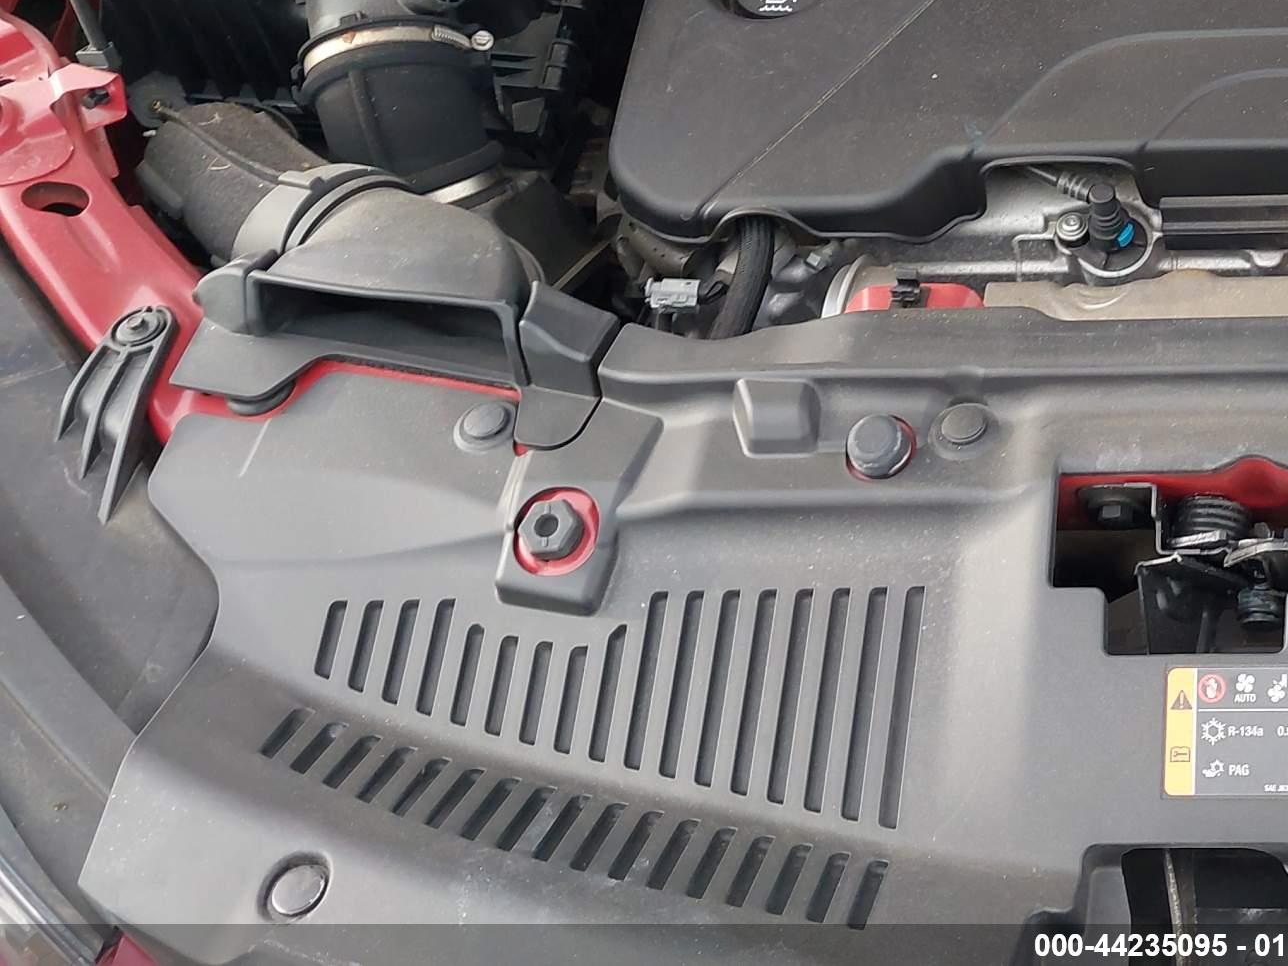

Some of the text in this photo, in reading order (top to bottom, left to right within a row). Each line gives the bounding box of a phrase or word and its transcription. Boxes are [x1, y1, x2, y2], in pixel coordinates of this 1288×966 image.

[1234, 694, 1256, 703] AUTO
[1228, 726, 1264, 736] R-134a
[1229, 765, 1249, 776] PAG
